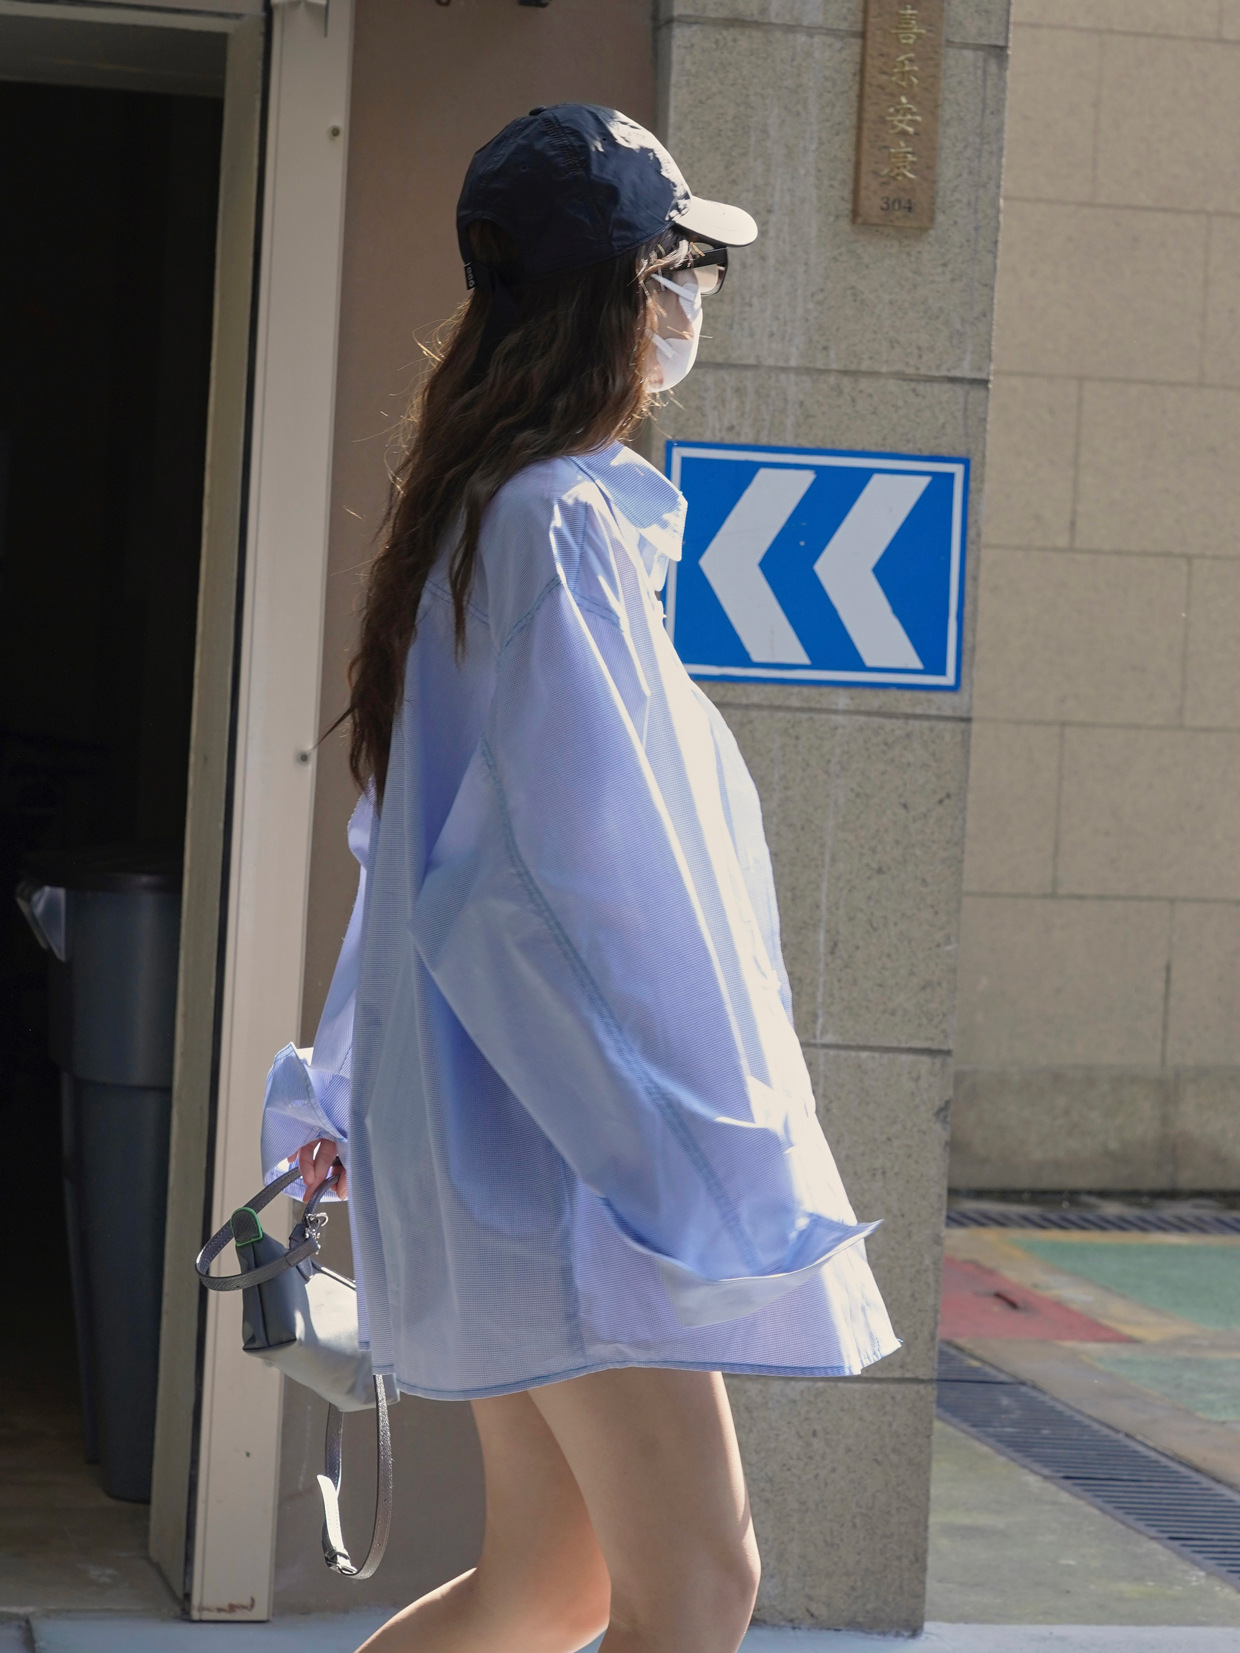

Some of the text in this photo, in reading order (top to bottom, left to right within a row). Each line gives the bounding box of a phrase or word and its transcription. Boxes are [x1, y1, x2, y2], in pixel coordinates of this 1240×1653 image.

[880, 4, 927, 181] 喜乐安康
[880, 196, 913, 213] 304
